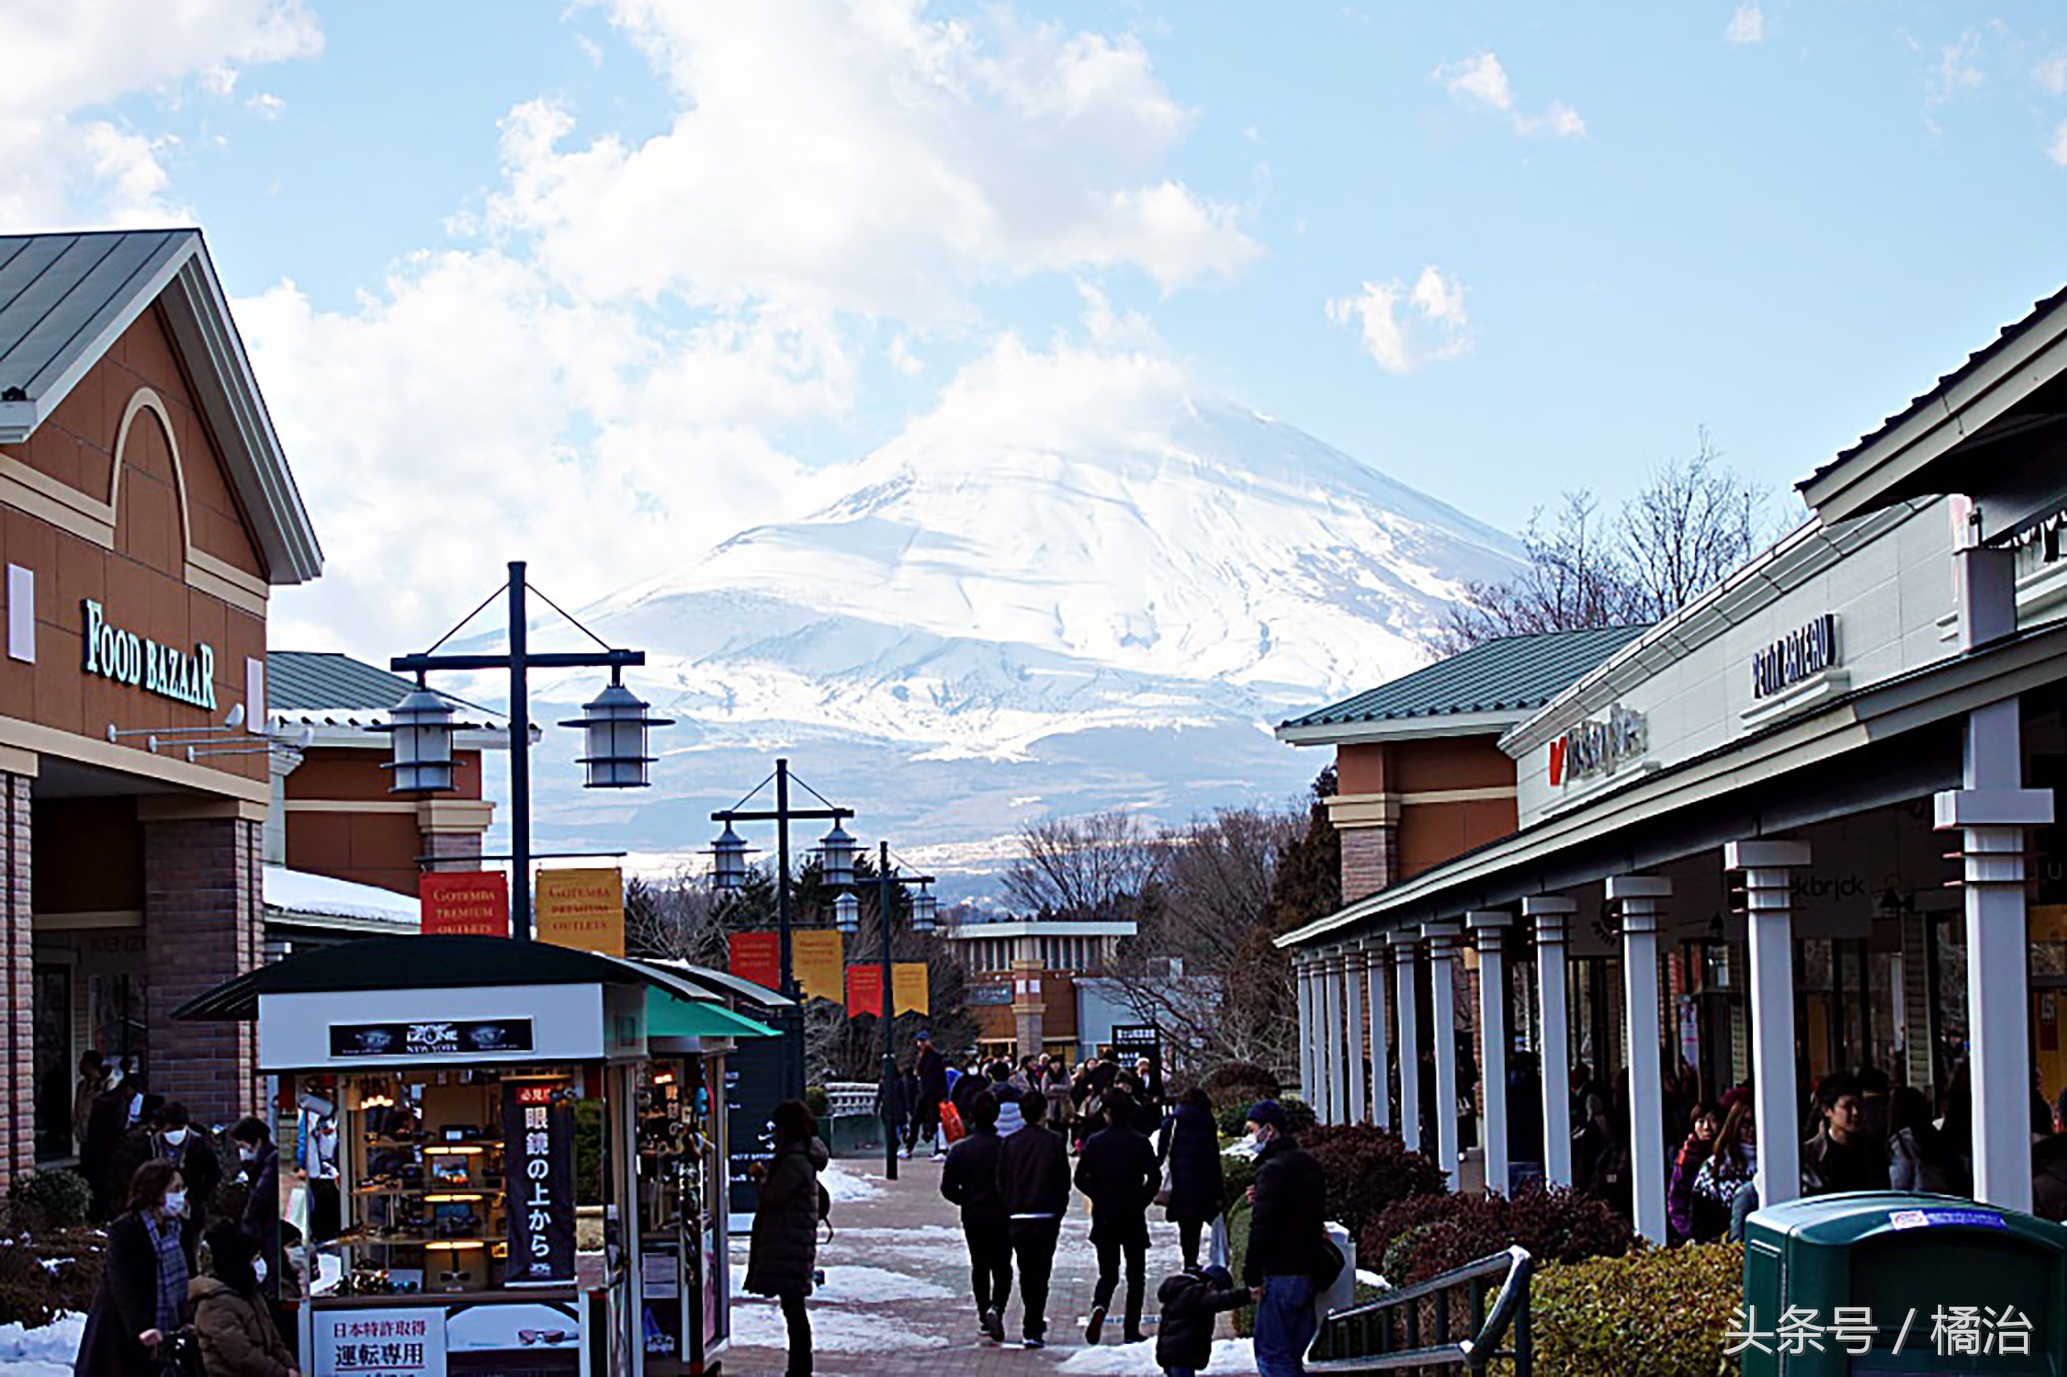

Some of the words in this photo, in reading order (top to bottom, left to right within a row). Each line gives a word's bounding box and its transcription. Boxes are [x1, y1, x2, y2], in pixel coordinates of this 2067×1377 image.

[81, 598, 141, 686] FOOD
[143, 637, 217, 711] BAZAAR
[433, 888, 496, 903] GOTEMBA
[524, 1106, 552, 1258] 眼鏡の上から
[333, 1319, 426, 1339] 日本特許取得
[334, 1342, 424, 1367] 運転専用
